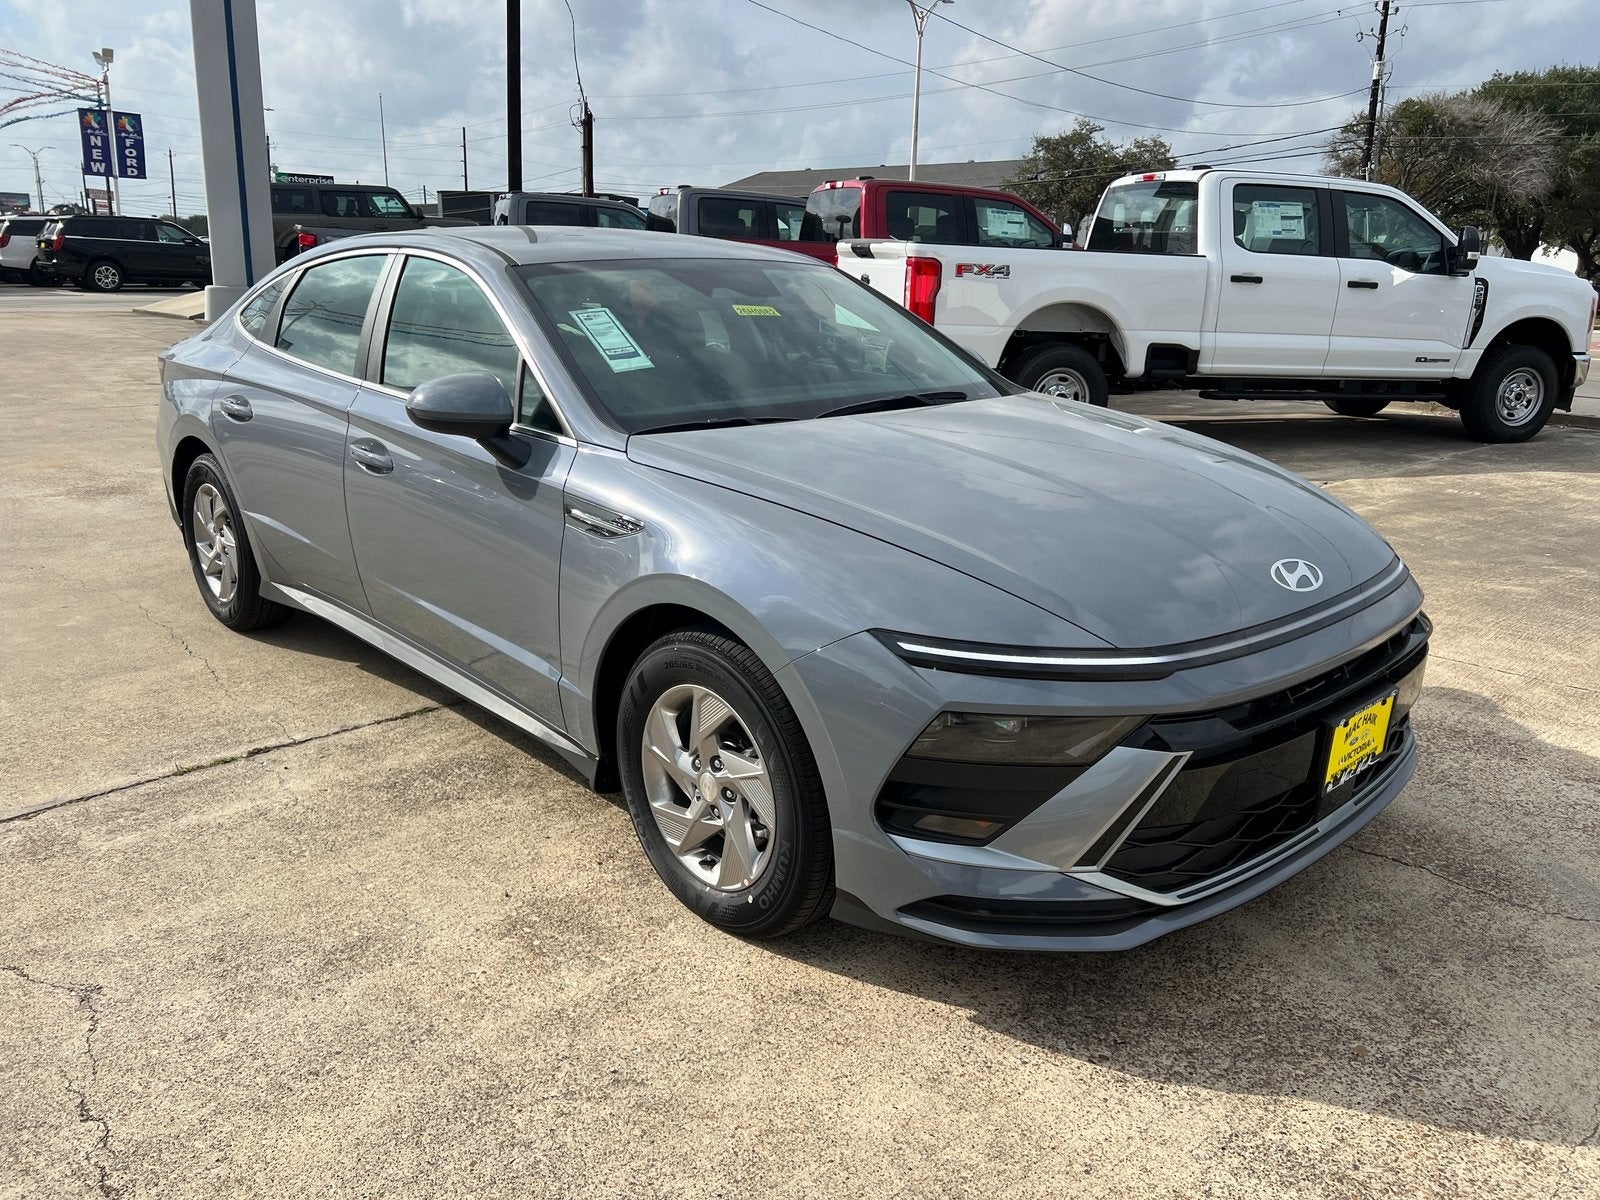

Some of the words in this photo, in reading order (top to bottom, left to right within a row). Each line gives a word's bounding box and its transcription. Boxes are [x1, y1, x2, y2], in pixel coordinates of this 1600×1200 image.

[90, 135, 105, 173] NEW
[124, 138, 138, 176] FORD
[279, 175, 334, 185] enterprise
[955, 263, 1010, 277] FX4
[1344, 717, 1362, 744] MAC
[758, 839, 791, 910] KUMHO
